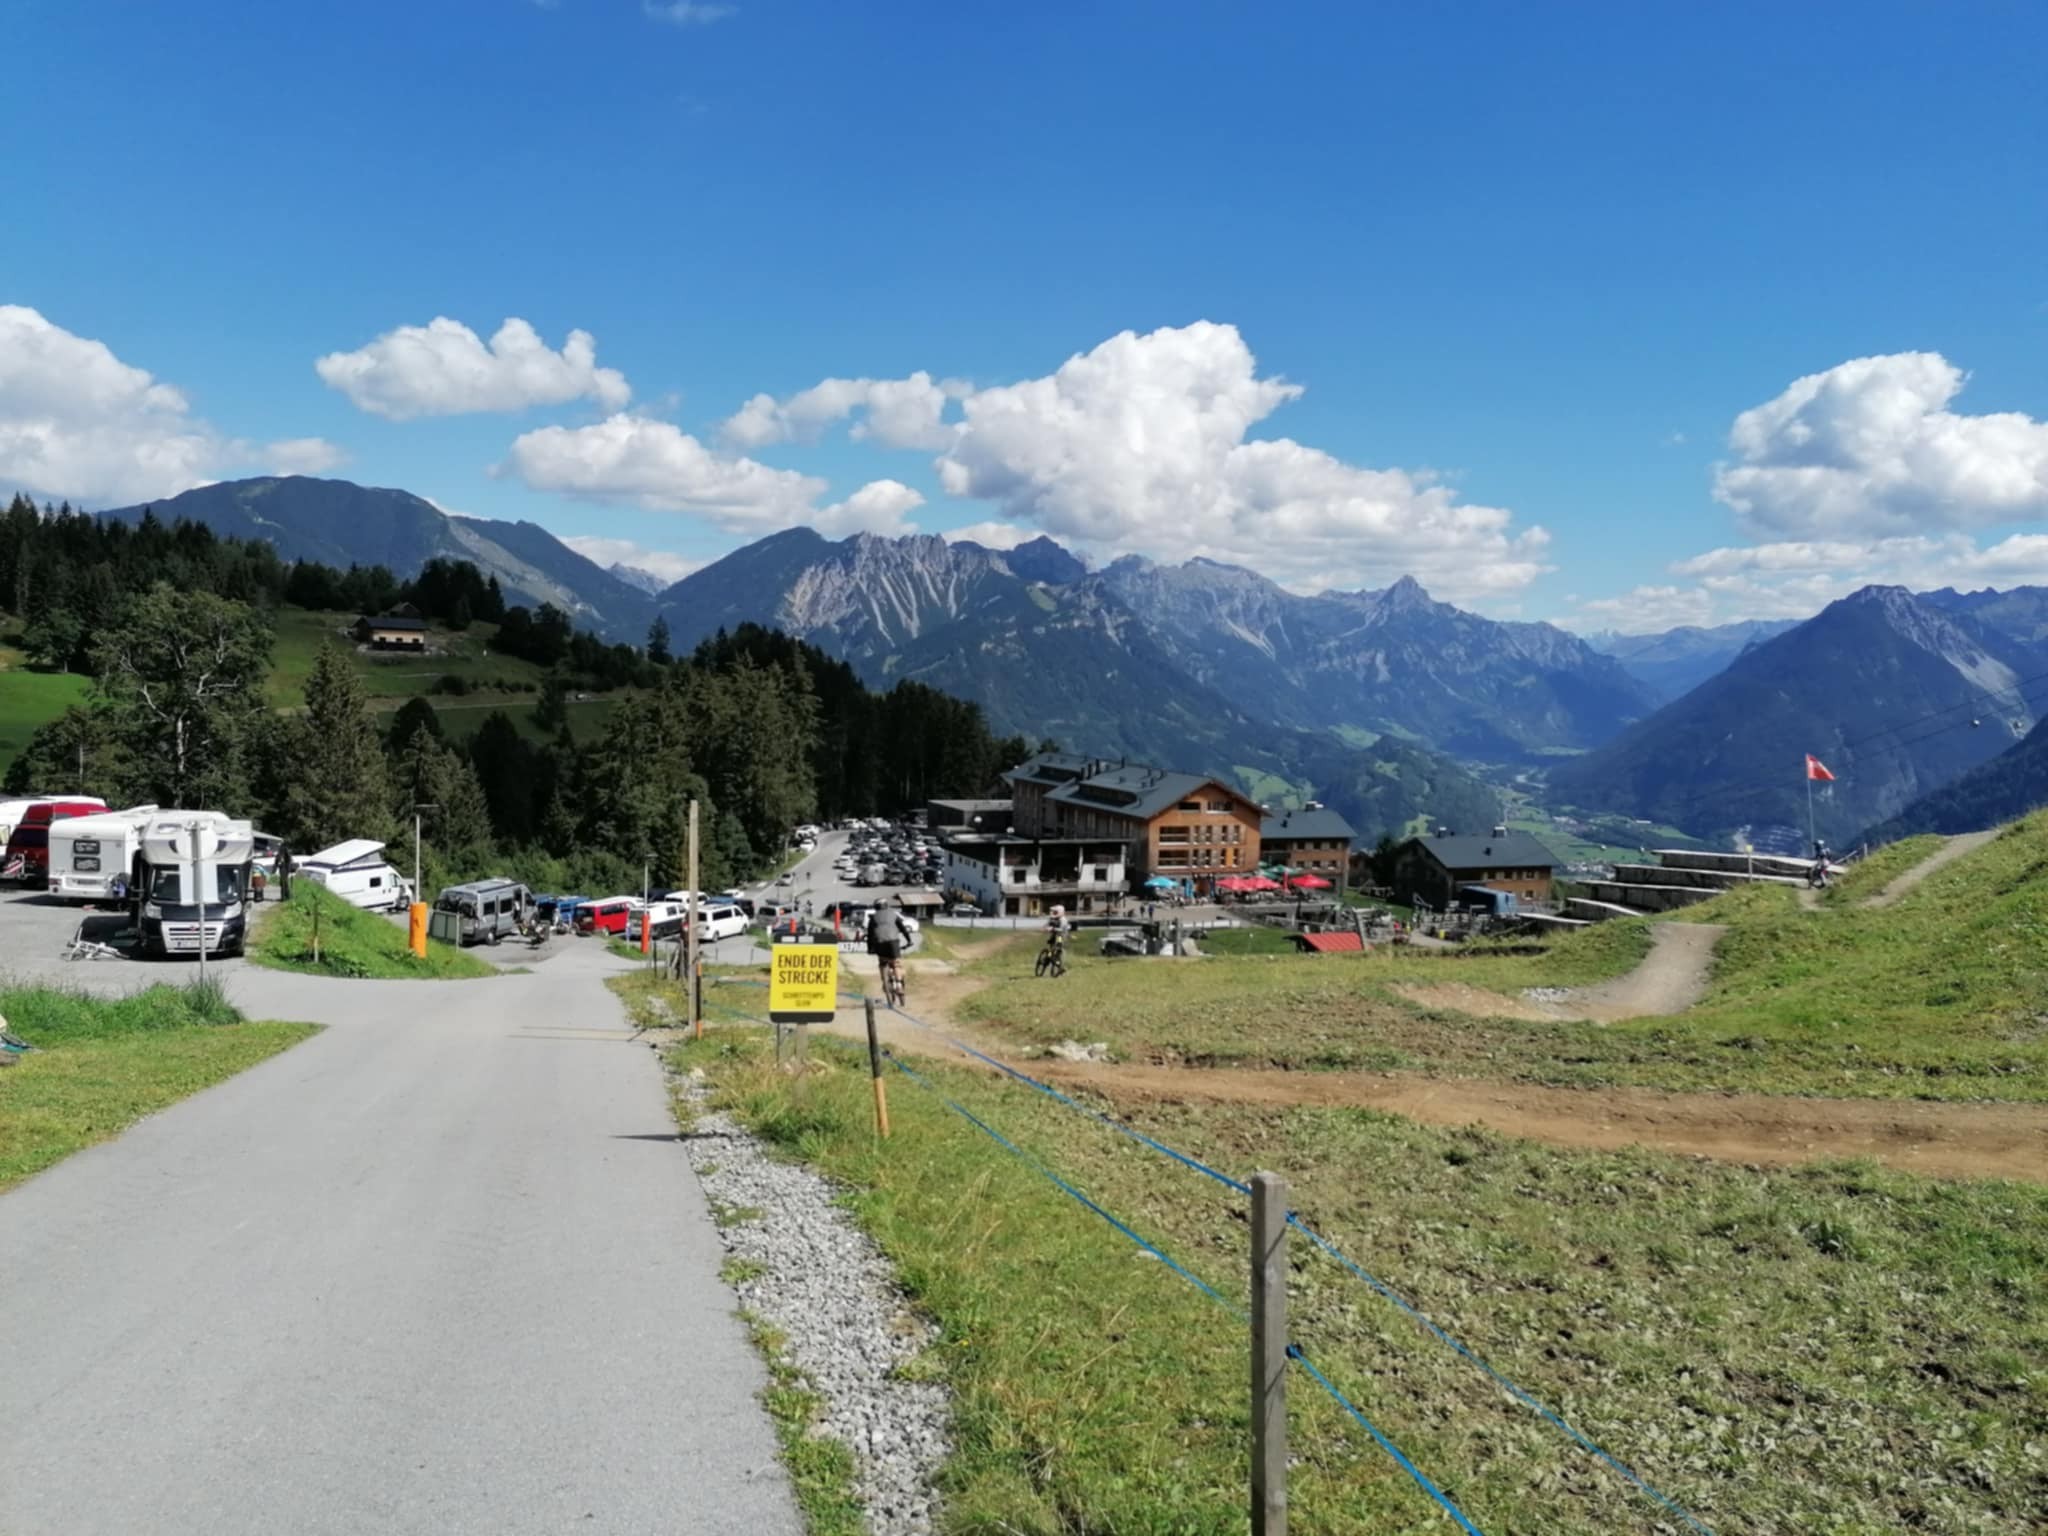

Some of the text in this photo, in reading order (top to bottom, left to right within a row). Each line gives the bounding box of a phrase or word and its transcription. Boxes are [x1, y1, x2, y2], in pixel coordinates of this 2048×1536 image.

[778, 954, 832, 968] ENDE DER
[779, 970, 829, 984] STRECKE
